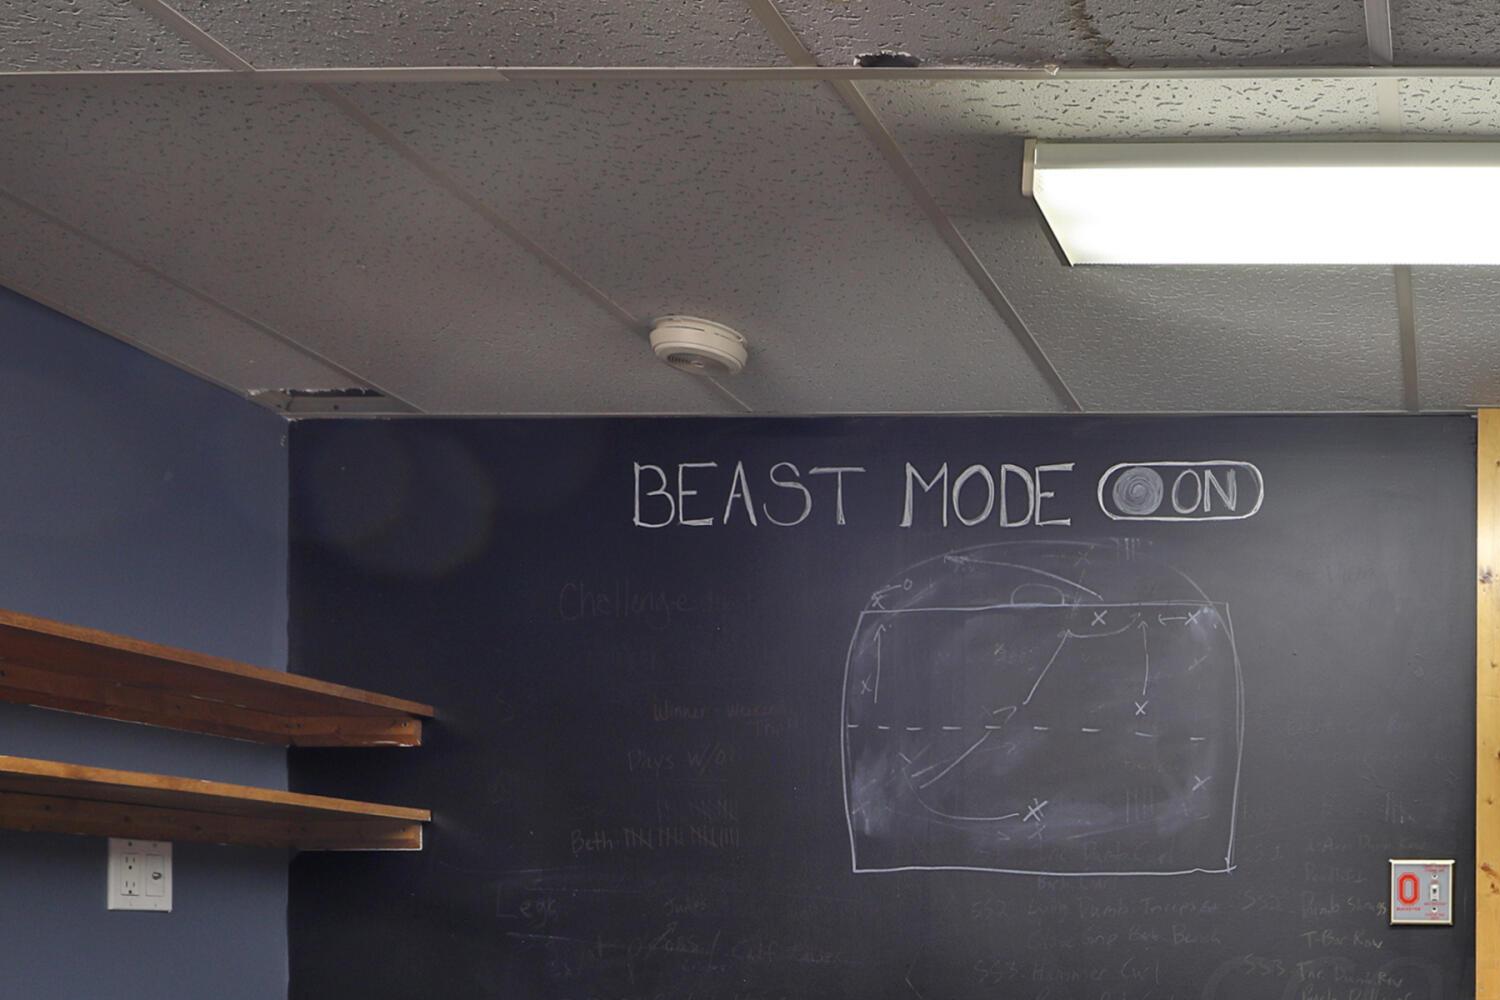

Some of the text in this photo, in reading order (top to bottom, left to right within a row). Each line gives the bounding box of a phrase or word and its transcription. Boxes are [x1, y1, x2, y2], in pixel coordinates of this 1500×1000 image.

[633, 460, 1238, 528] BEAST MODE ON
